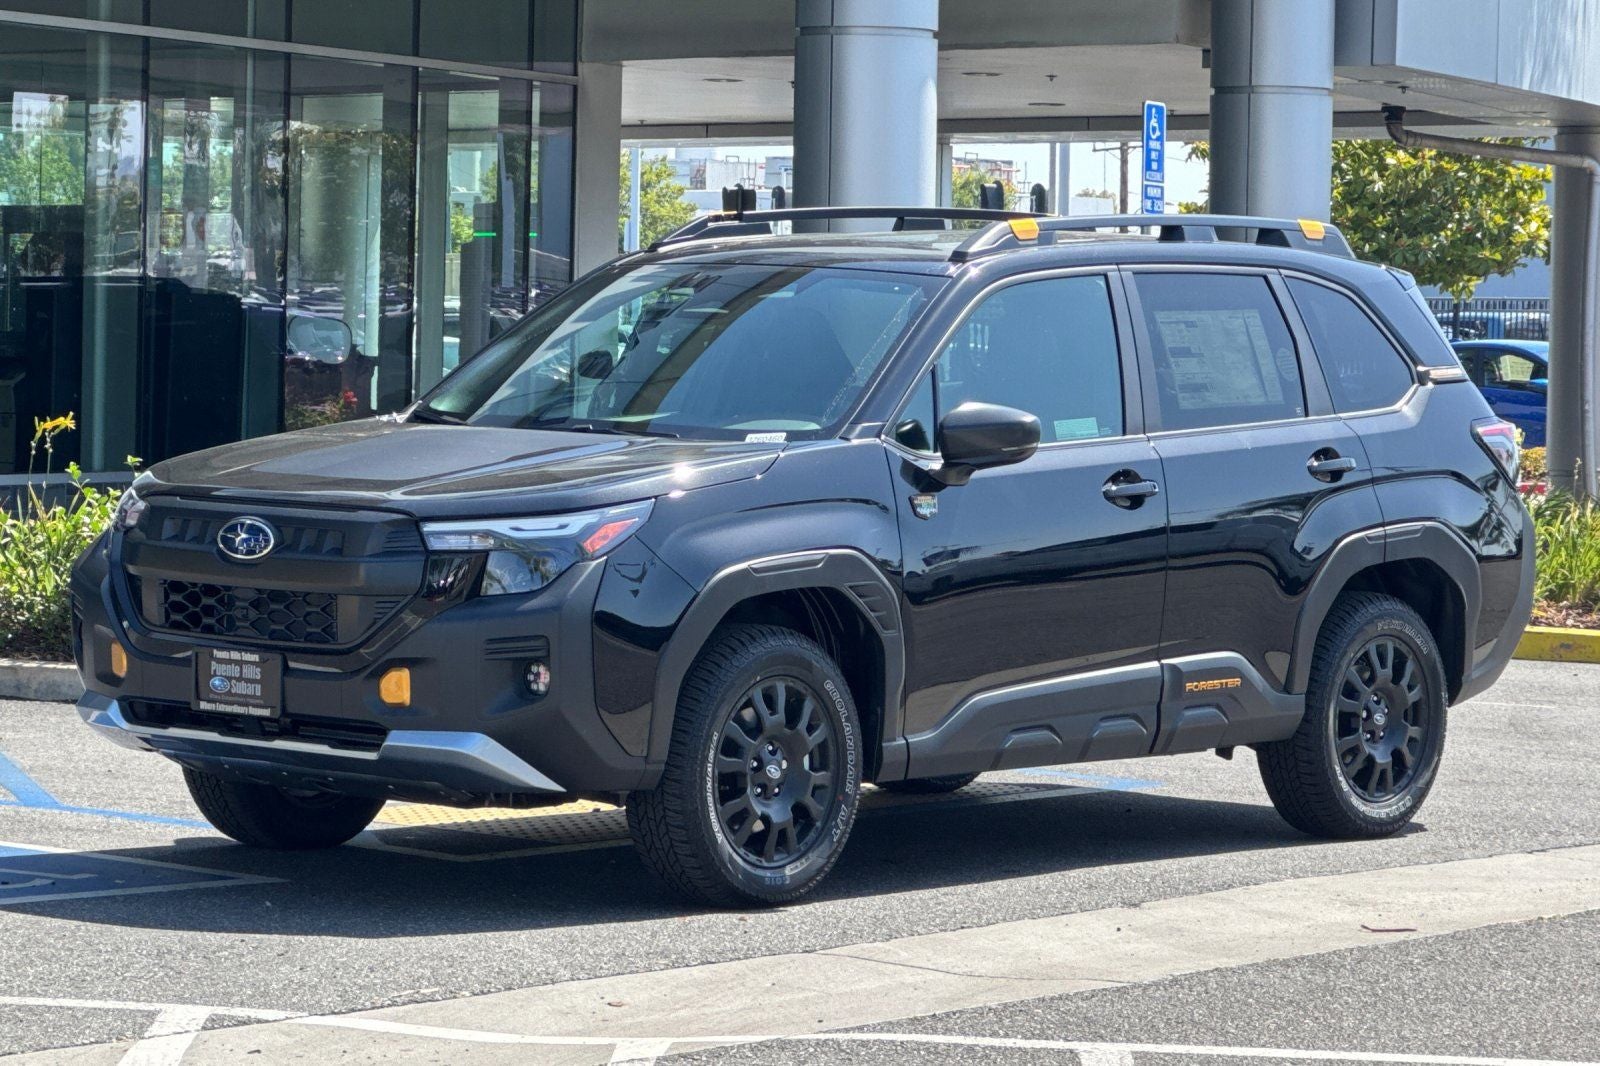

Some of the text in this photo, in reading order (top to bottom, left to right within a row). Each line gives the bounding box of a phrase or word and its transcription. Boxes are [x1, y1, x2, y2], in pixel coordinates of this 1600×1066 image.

[213, 649, 259, 662] Puente Hills Subaru
[211, 661, 261, 680] Puente Hills
[231, 679, 262, 697] Subaru
[1185, 677, 1242, 693] FORESTER
[200, 700, 216, 711] Where
[216, 702, 248, 715] Extraordinary
[823, 679, 855, 842] GEOLANDAR A/T
[706, 731, 723, 844] YOKOHAMA
